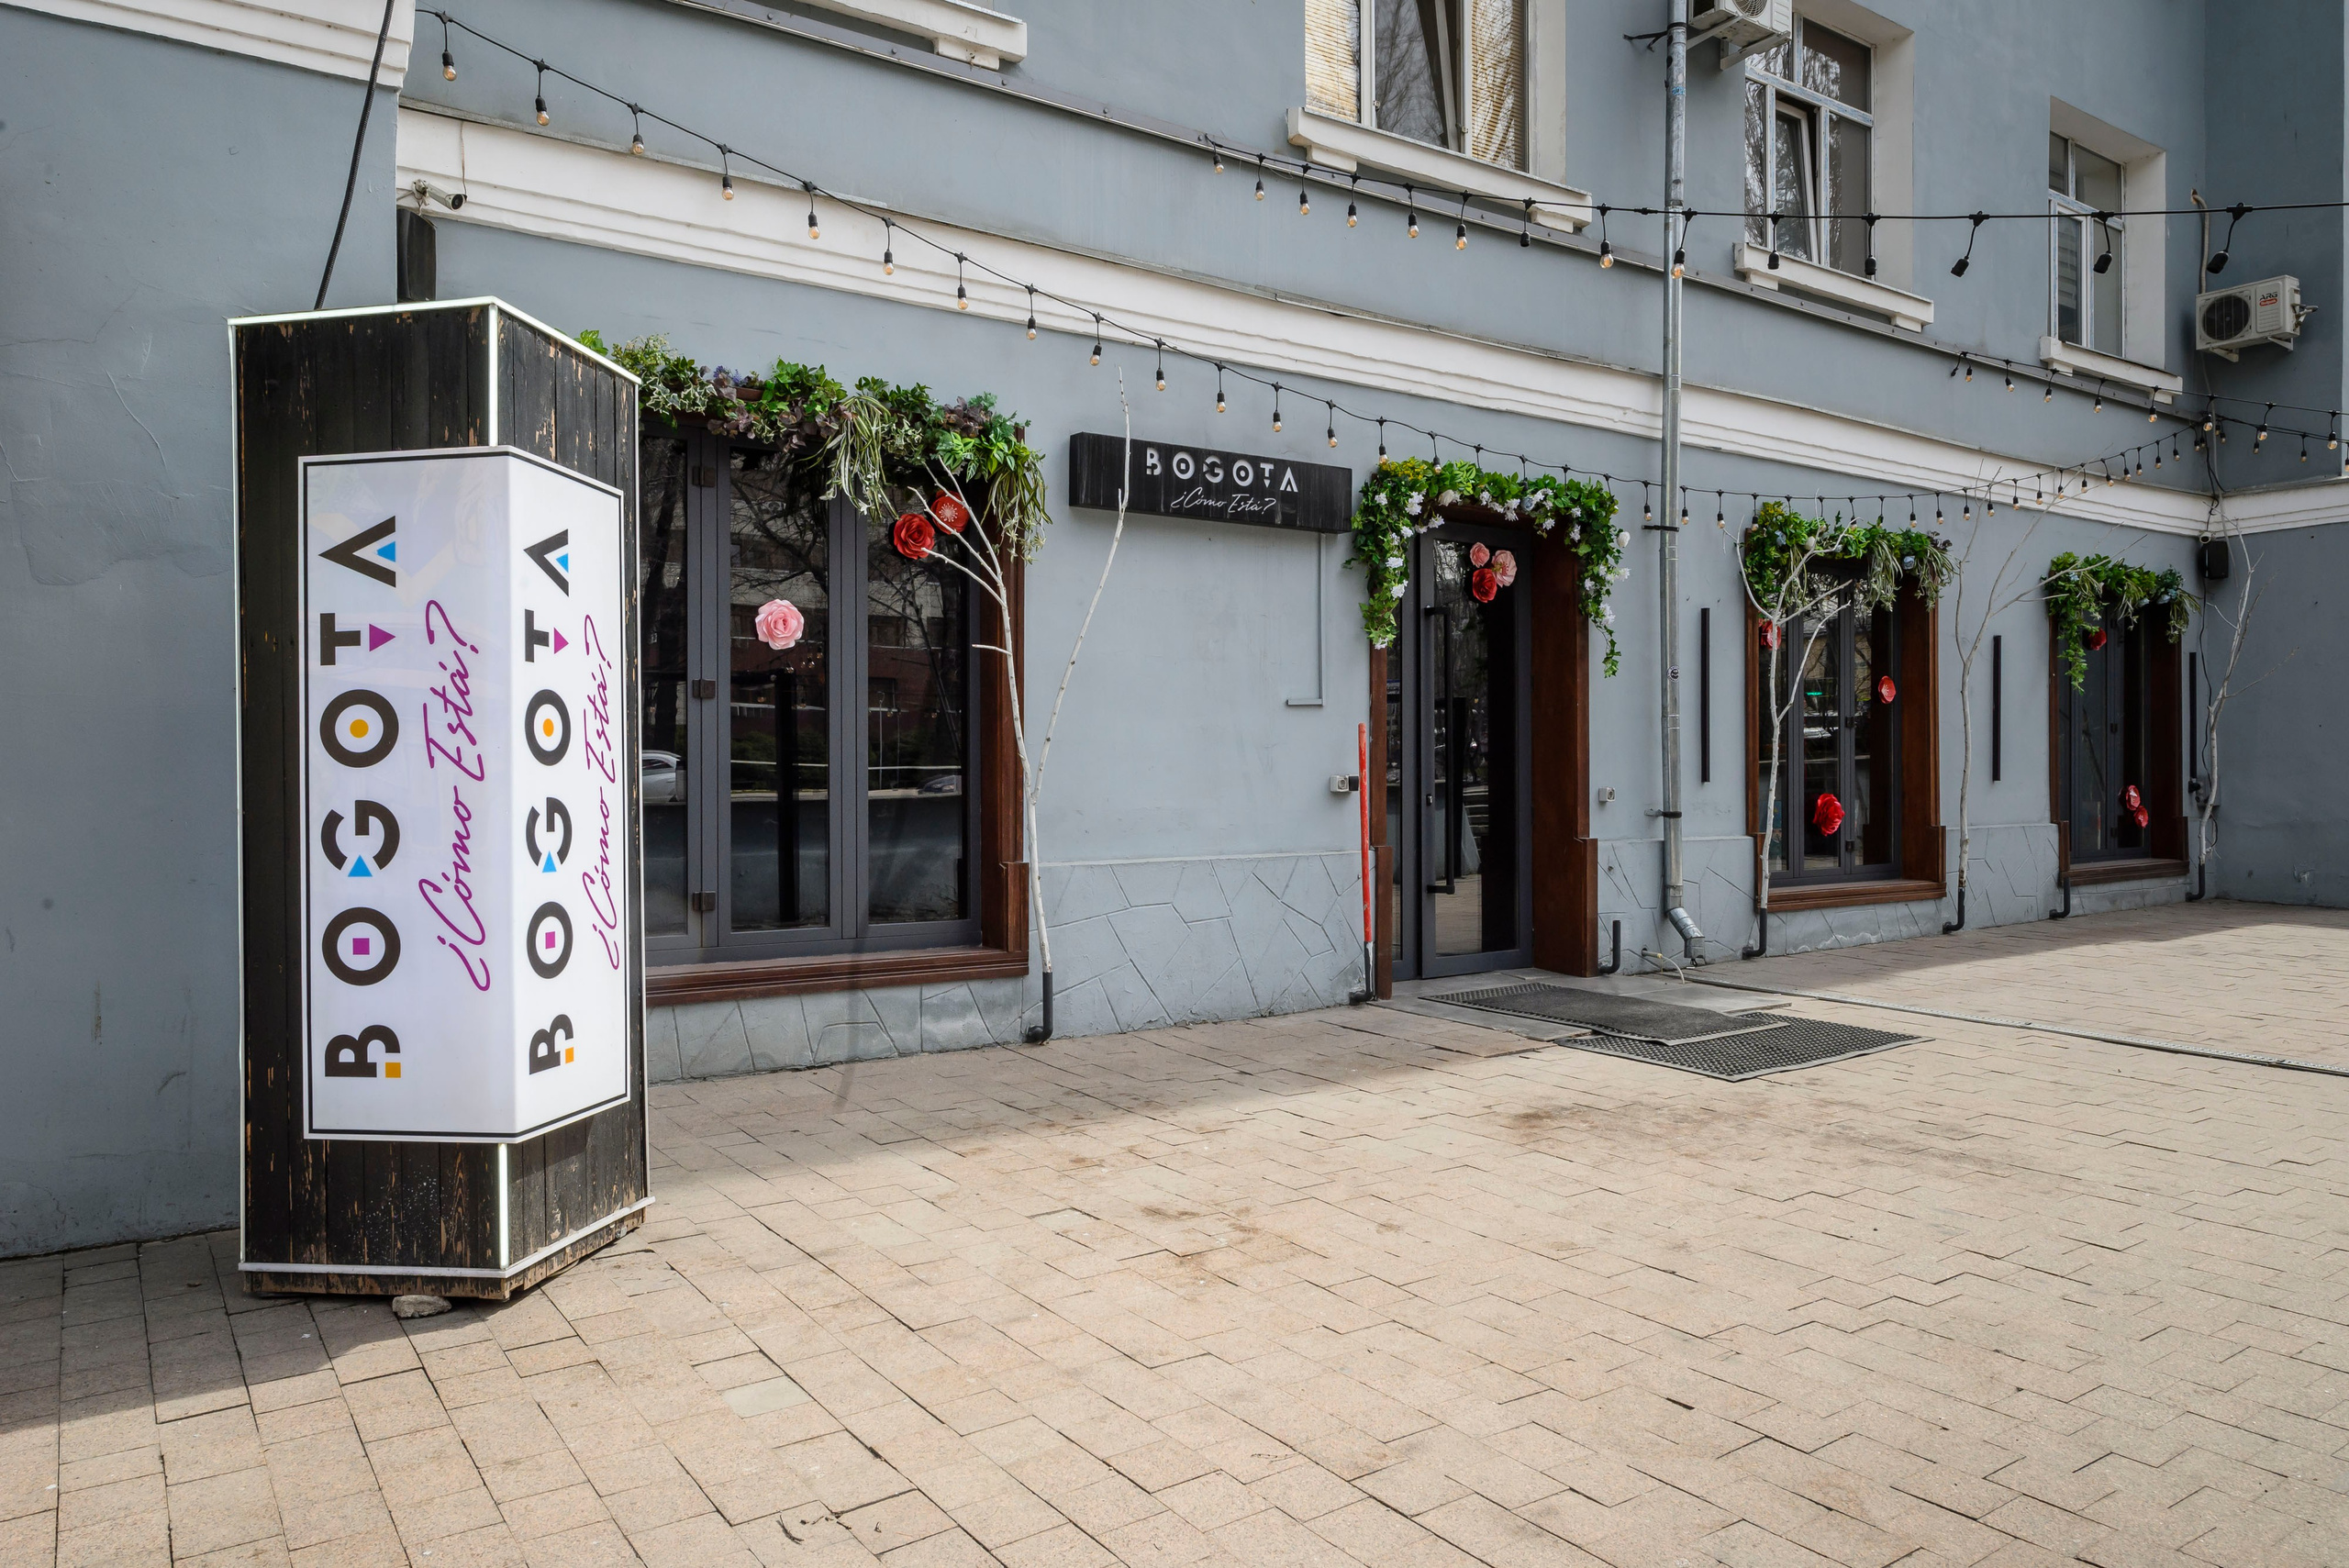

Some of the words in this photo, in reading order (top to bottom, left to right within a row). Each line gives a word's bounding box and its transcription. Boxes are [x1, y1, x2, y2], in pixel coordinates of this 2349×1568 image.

[1146, 448, 1298, 493] BOGOTA
[424, 599, 485, 782] Está?
[583, 614, 617, 784] Está?
[318, 515, 401, 1078] BOGOTA
[418, 783, 491, 991] ¿Cómo
[523, 528, 575, 1075] BOGOTA
[582, 785, 620, 970] ¿Cómo
